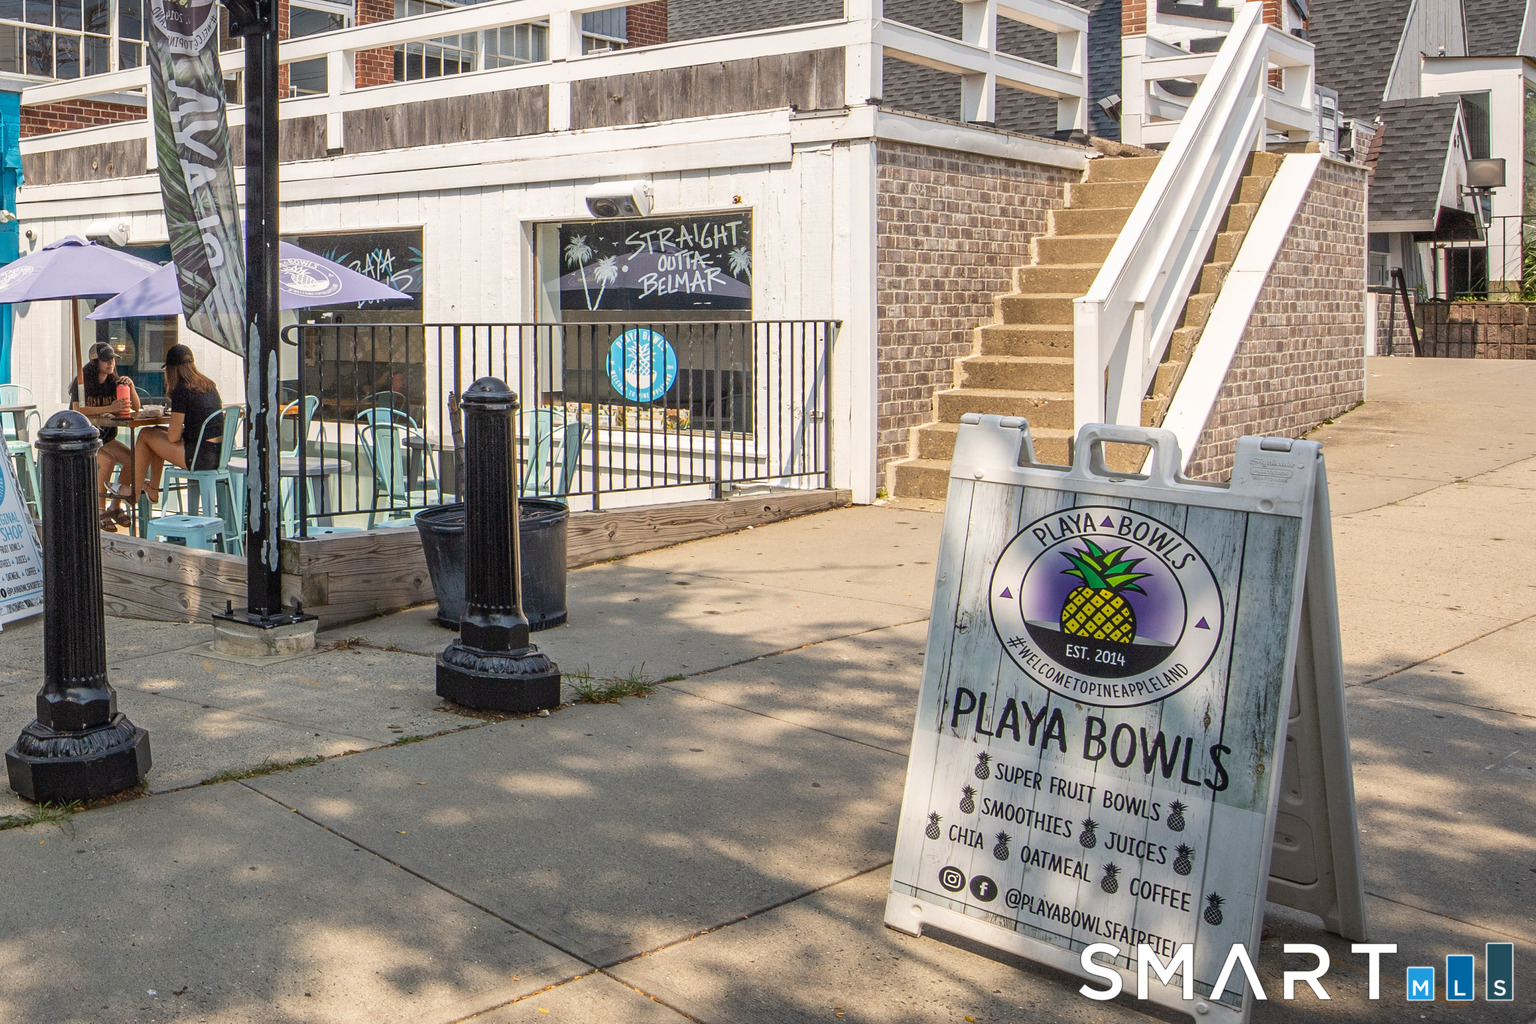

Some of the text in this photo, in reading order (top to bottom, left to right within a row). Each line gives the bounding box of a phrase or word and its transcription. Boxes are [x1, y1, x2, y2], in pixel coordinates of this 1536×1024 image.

[624, 220, 743, 261] STRAIGHT
[657, 248, 713, 273] OUTTA
[637, 266, 727, 300] BELMAR
[0, 524, 24, 543] SHOP
[1031, 512, 1197, 571] PLAYA BOWLS
[1006, 635, 1189, 699] #WELCOMETOPINEAPPLELAND
[1065, 643, 1126, 667] EST. 2014
[949, 686, 1232, 792] PLAYA BOWLS
[994, 762, 1162, 822] SUPER FRUIT BOWLS
[981, 797, 1168, 866] SMOOTHIES JUICES
[948, 824, 1193, 913] CHIA OATMEAL COFFEE
